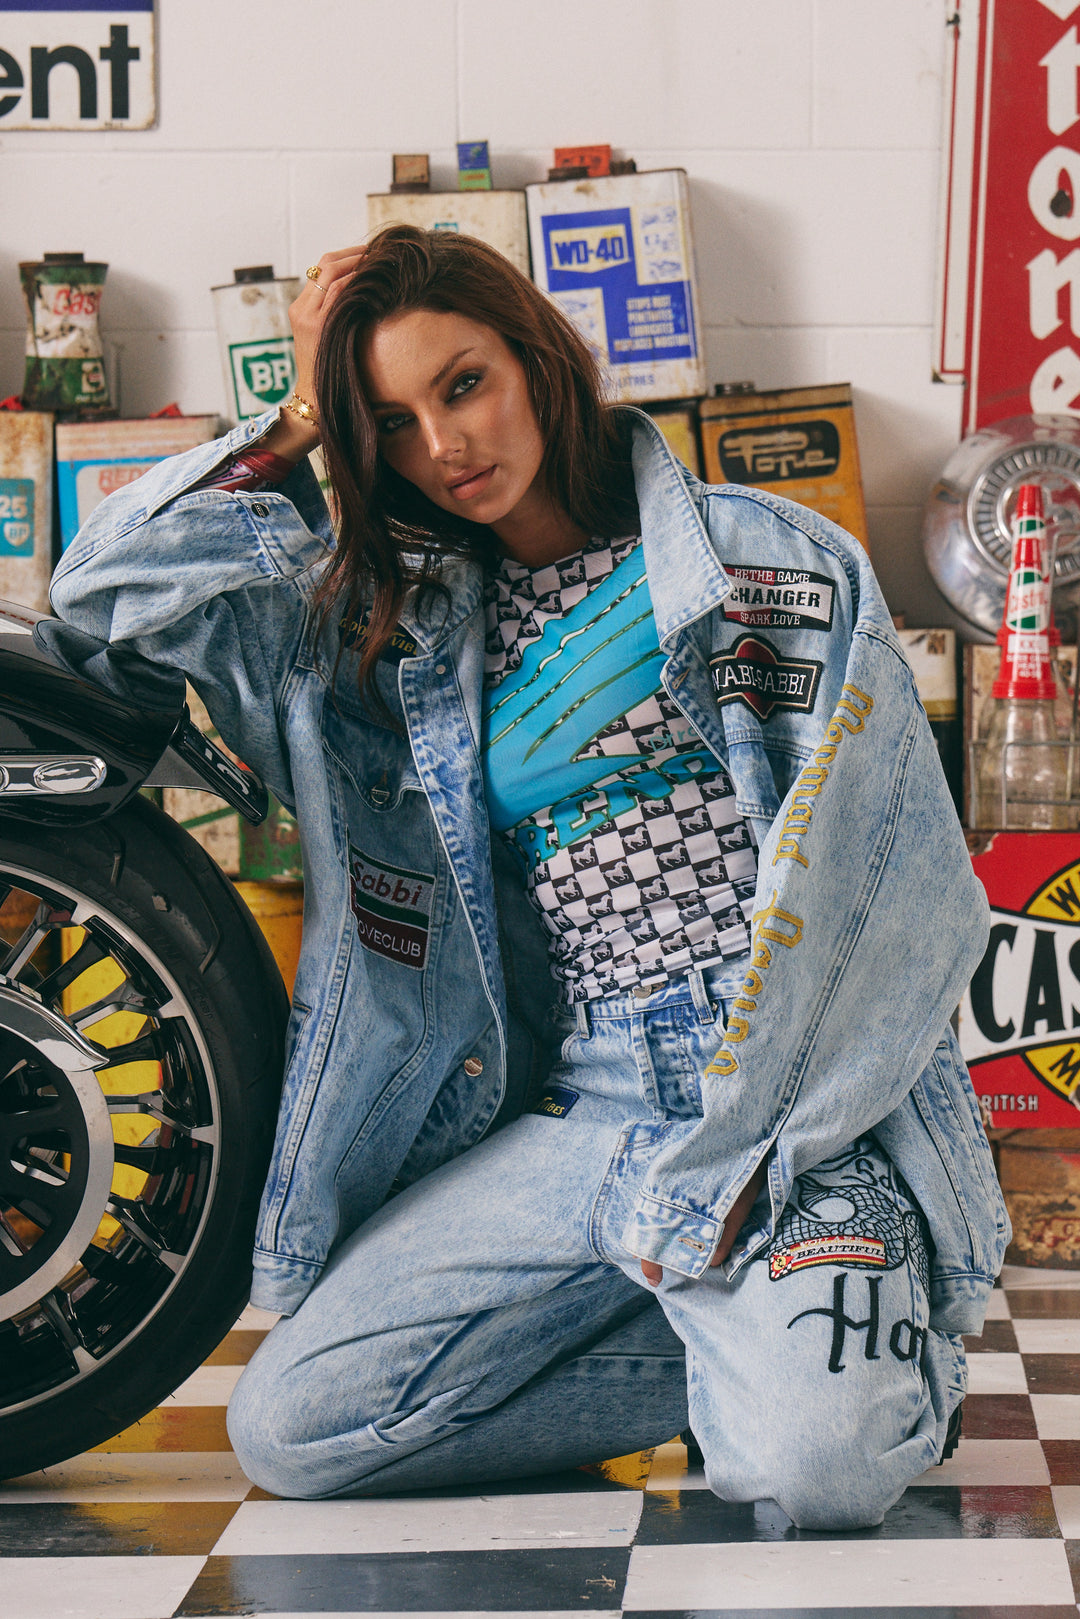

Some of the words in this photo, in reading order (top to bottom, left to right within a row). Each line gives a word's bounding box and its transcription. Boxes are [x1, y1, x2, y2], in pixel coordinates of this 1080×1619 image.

[1026, 0, 1080, 414] tone
[554, 236, 625, 267] WD-40
[53, 289, 102, 315] Cas
[248, 359, 292, 393] BP
[777, 571, 811, 584] GAME
[730, 586, 820, 608] CHANGER
[740, 611, 771, 626] SPARK
[772, 614, 801, 626] LOVE
[353, 861, 423, 906] Sabbi
[1046, 871, 1080, 917] W
[358, 920, 422, 957] OVECLUB
[970, 923, 1080, 1043] CA
[975, 1094, 1039, 1112] RITISH
[797, 1243, 886, 1259] BEAUTIFUL
